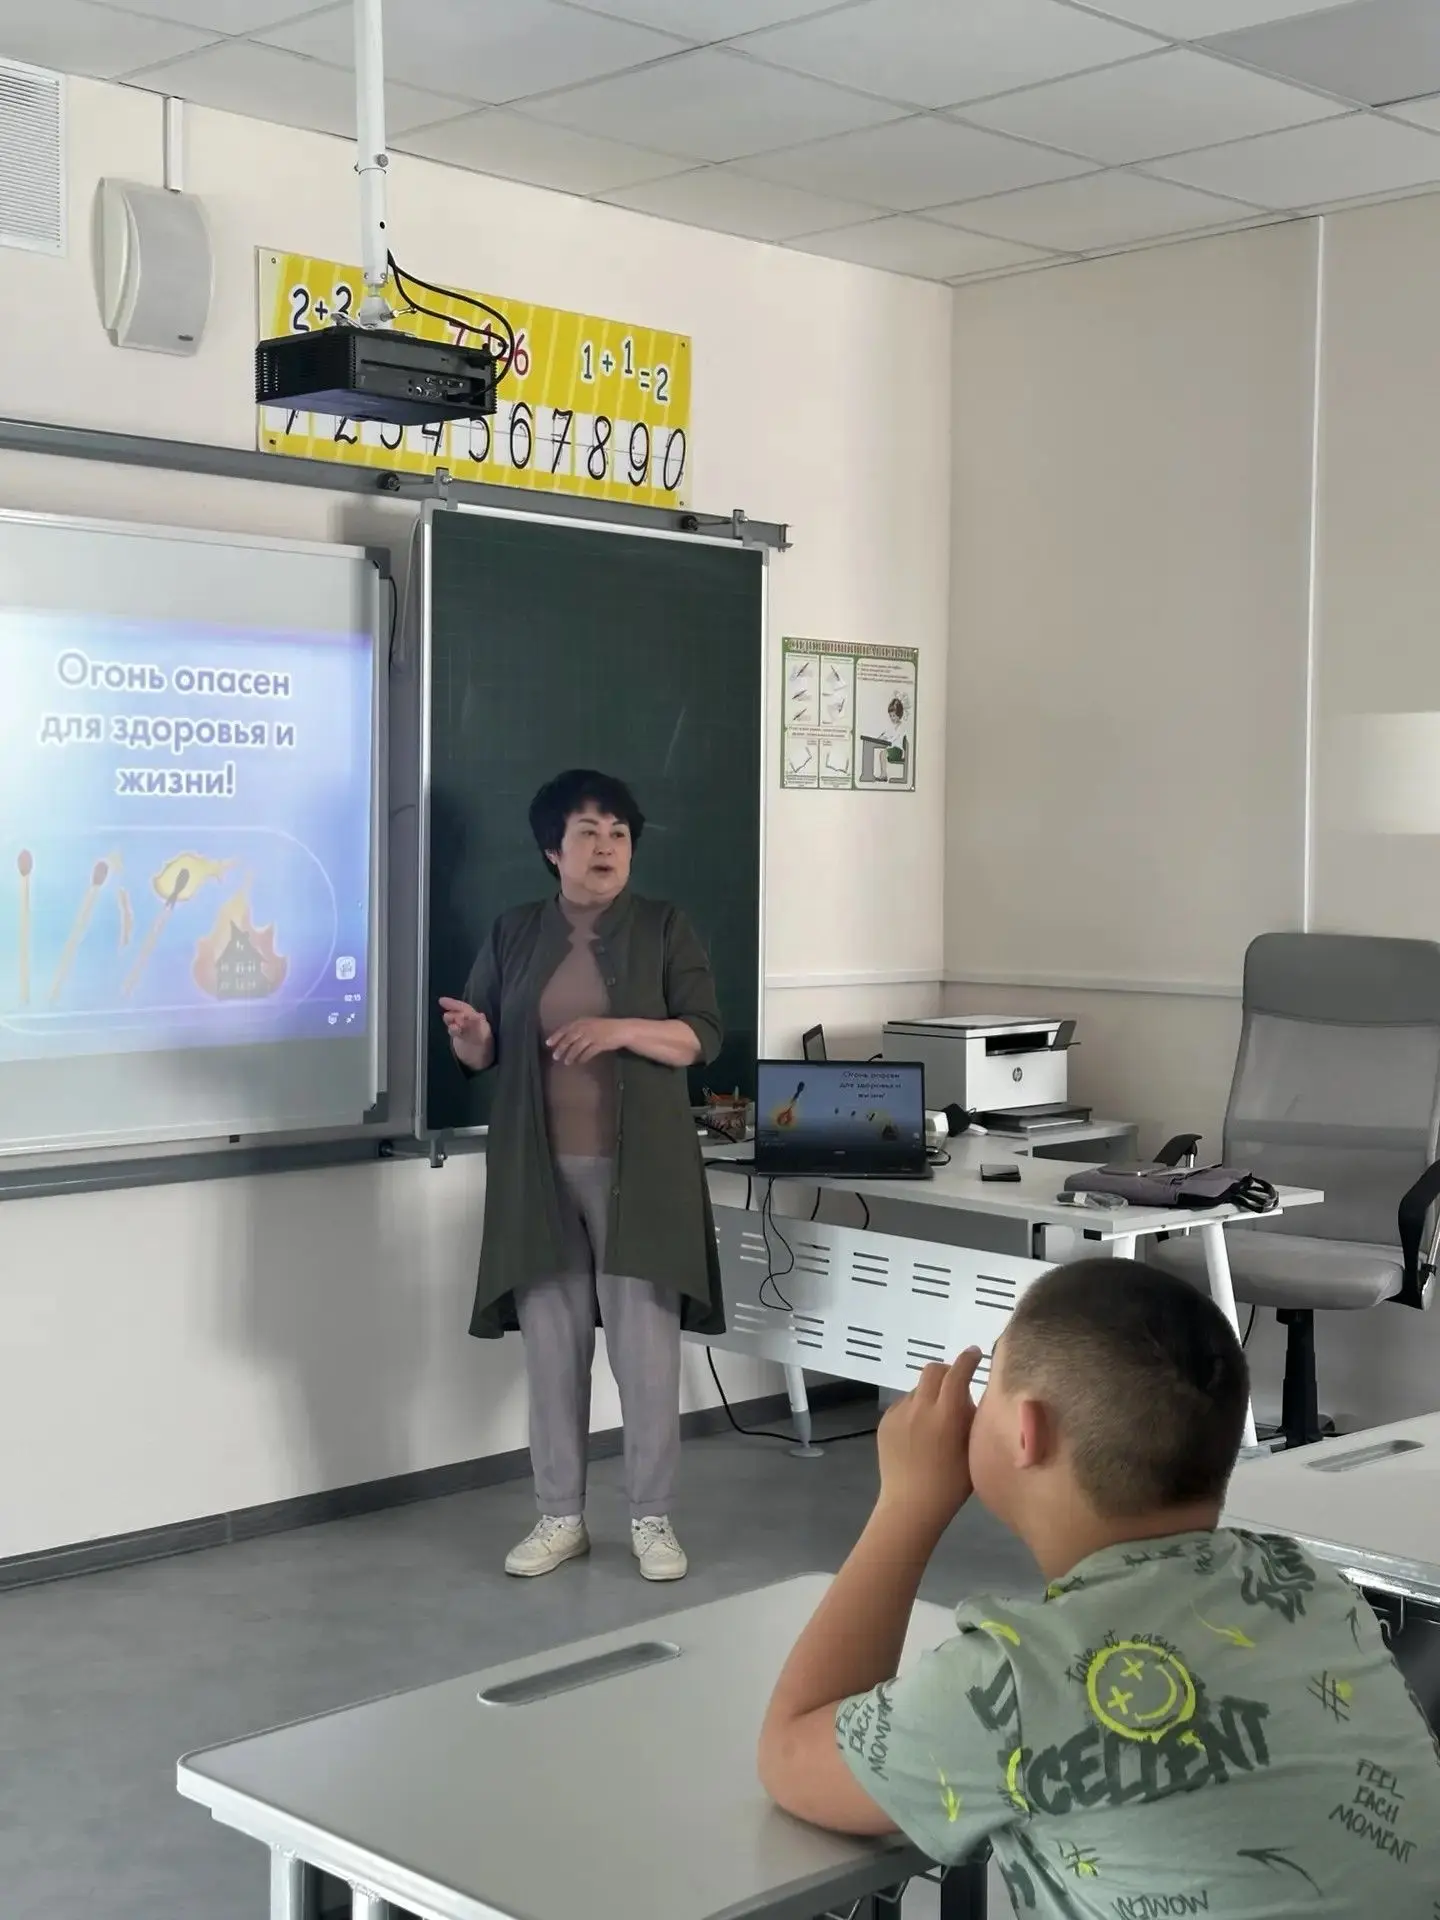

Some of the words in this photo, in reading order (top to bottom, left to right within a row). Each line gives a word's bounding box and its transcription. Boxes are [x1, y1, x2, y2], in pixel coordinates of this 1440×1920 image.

[510, 402, 533, 469] 6
[551, 409, 573, 474] 7
[587, 415, 613, 480] 8
[628, 422, 650, 487] 9
[662, 428, 686, 491] 0
[57, 652, 165, 690] Огонь
[174, 668, 291, 696] опасен
[40, 715, 102, 744] для
[112, 717, 266, 752] здоровья
[276, 724, 295, 746] и
[118, 763, 235, 795] жизни!
[1356, 1757, 1405, 1801] FEEL
[1352, 1784, 1400, 1825] EACH
[1328, 1803, 1418, 1864] MOMENT
